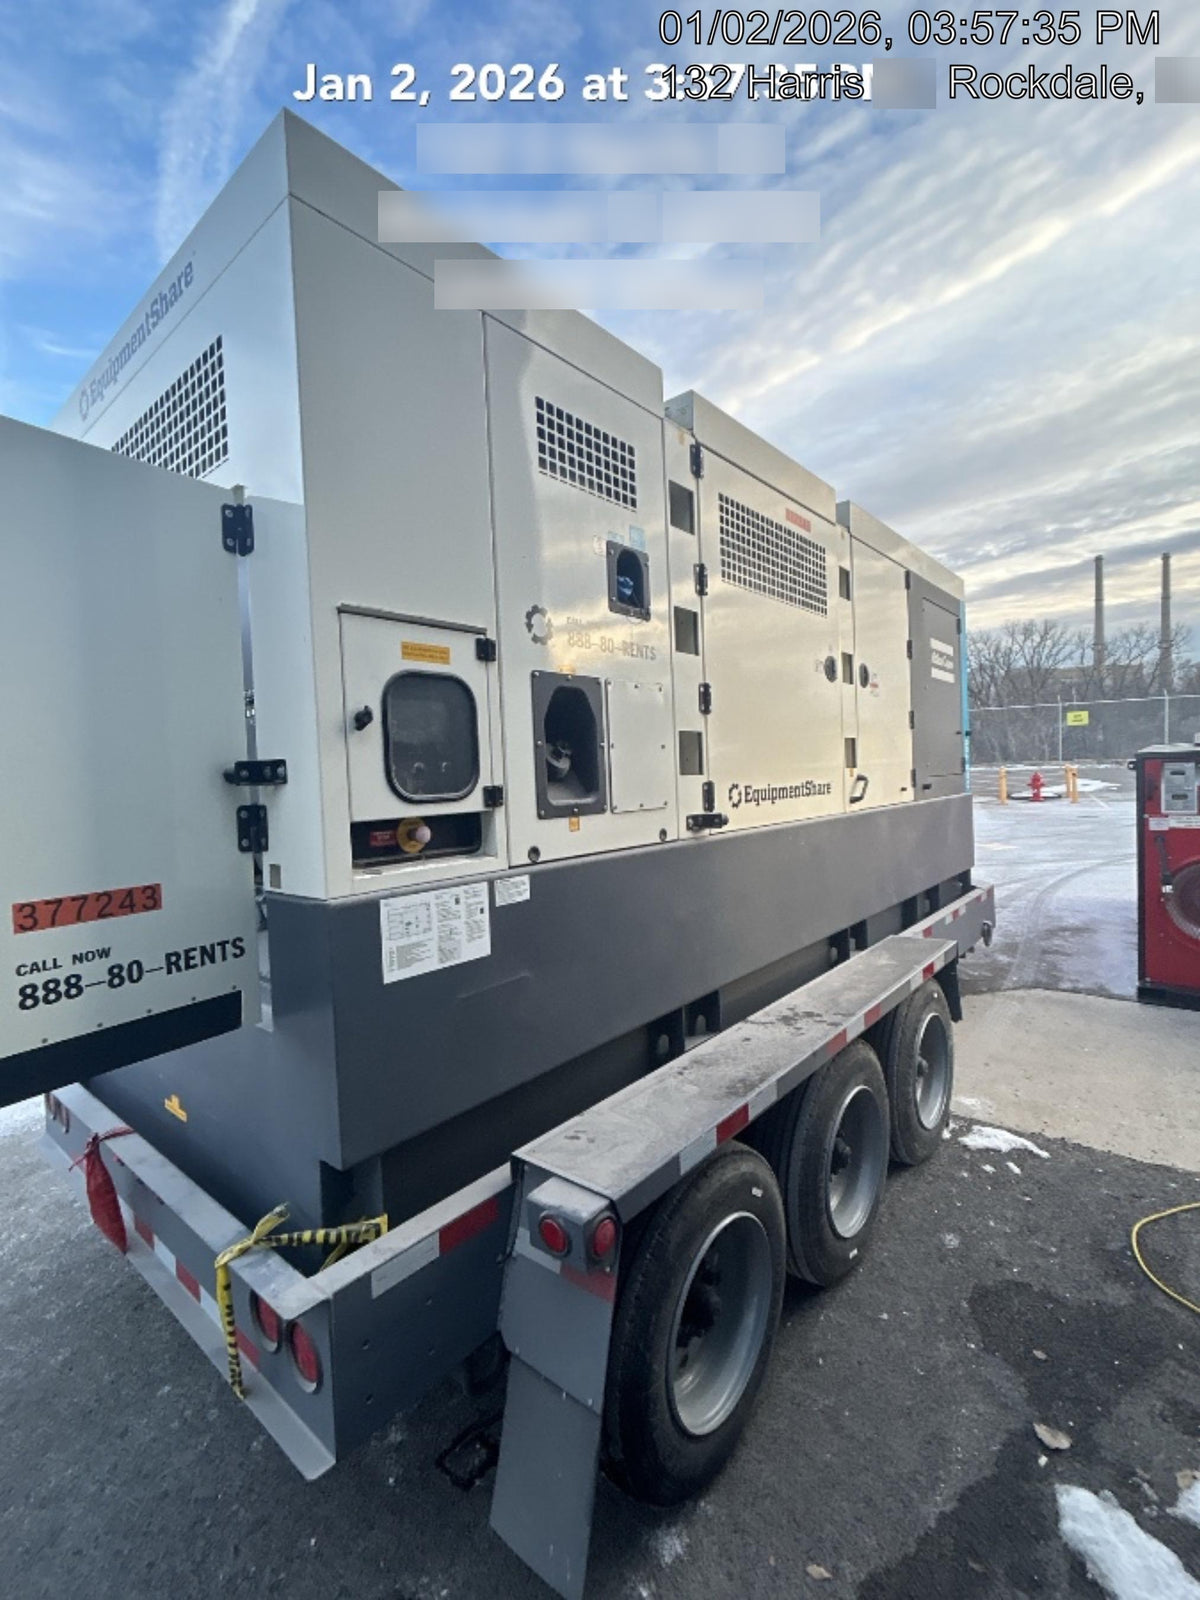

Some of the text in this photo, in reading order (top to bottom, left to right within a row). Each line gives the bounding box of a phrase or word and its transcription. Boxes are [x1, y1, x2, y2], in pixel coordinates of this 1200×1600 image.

[89, 260, 194, 406] EquipmentShare
[743, 780, 832, 806] EquipmentShare
[17, 884, 161, 933] 377243
[15, 946, 112, 977] CALL NOW
[18, 936, 246, 1011] 888-80-RENTS
